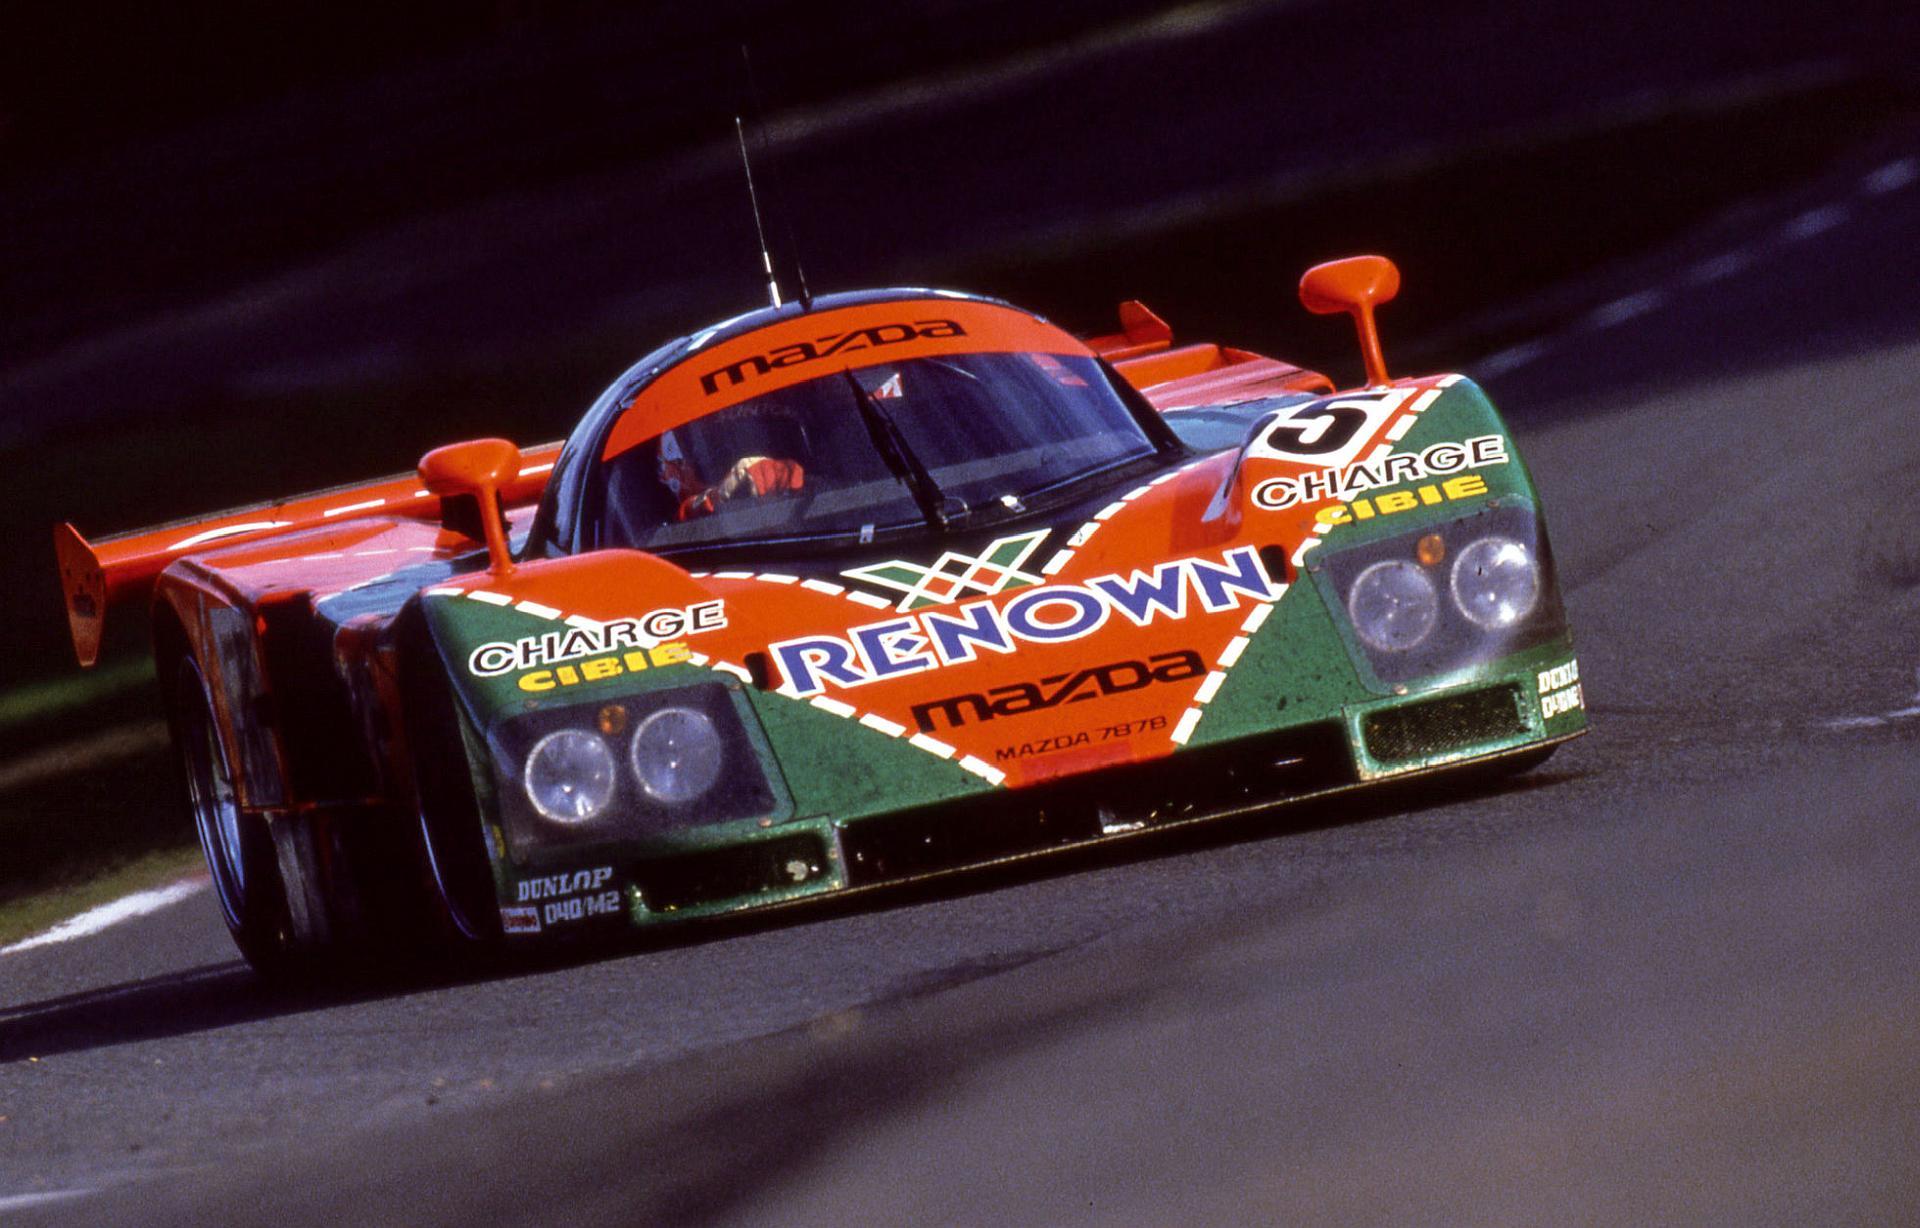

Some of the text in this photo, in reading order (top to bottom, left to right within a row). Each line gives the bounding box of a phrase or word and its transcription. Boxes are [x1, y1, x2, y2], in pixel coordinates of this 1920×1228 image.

[700, 319, 966, 395] mazda
[1252, 434, 1509, 511] CHARGE
[1315, 474, 1488, 526] CIBIE
[469, 599, 727, 677] CHARGE
[770, 546, 1278, 697] RENOWN
[518, 642, 694, 692] CIBIE
[911, 649, 1207, 732] mazda
[995, 715, 1168, 761] MAZDA 787B
[517, 866, 613, 902] DUNLOP
